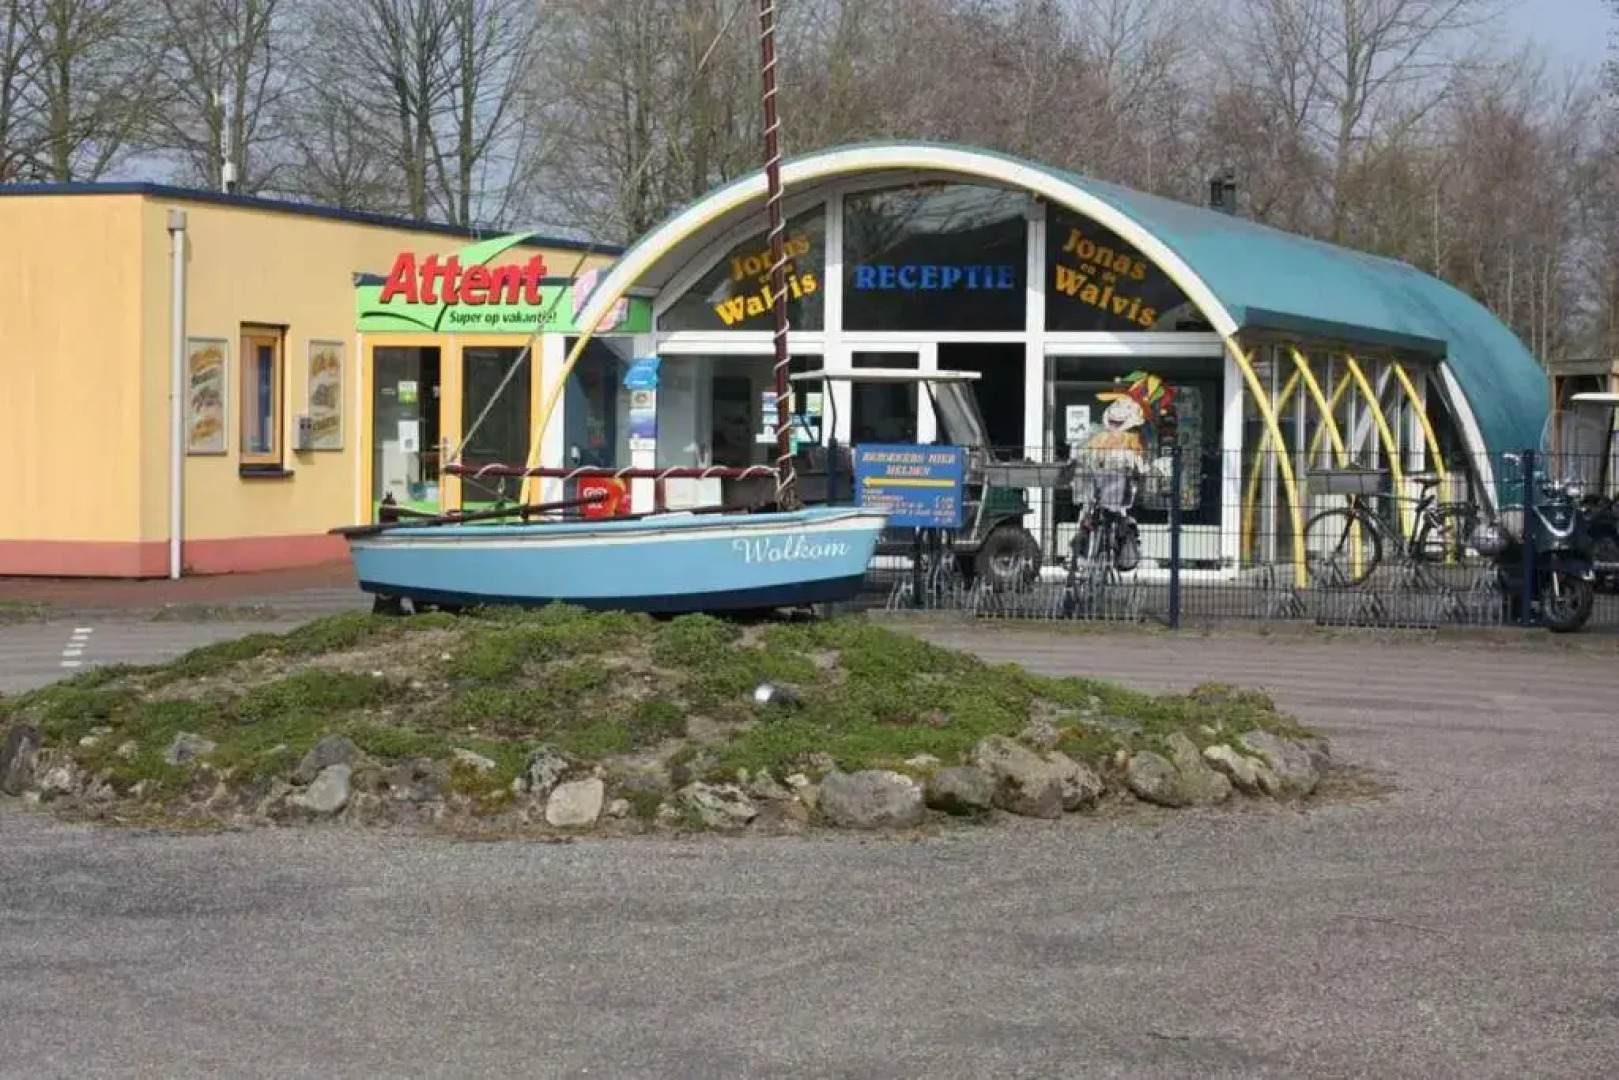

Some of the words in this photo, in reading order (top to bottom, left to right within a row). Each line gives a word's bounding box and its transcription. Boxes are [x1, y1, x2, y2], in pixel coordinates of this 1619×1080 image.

[378, 252, 548, 306] Attent
[854, 265, 1015, 289] RECEPTIE
[1062, 228, 1147, 280] Jonas
[449, 311, 482, 326] Super
[484, 312, 500, 326] op
[1055, 263, 1158, 327] Walvis
